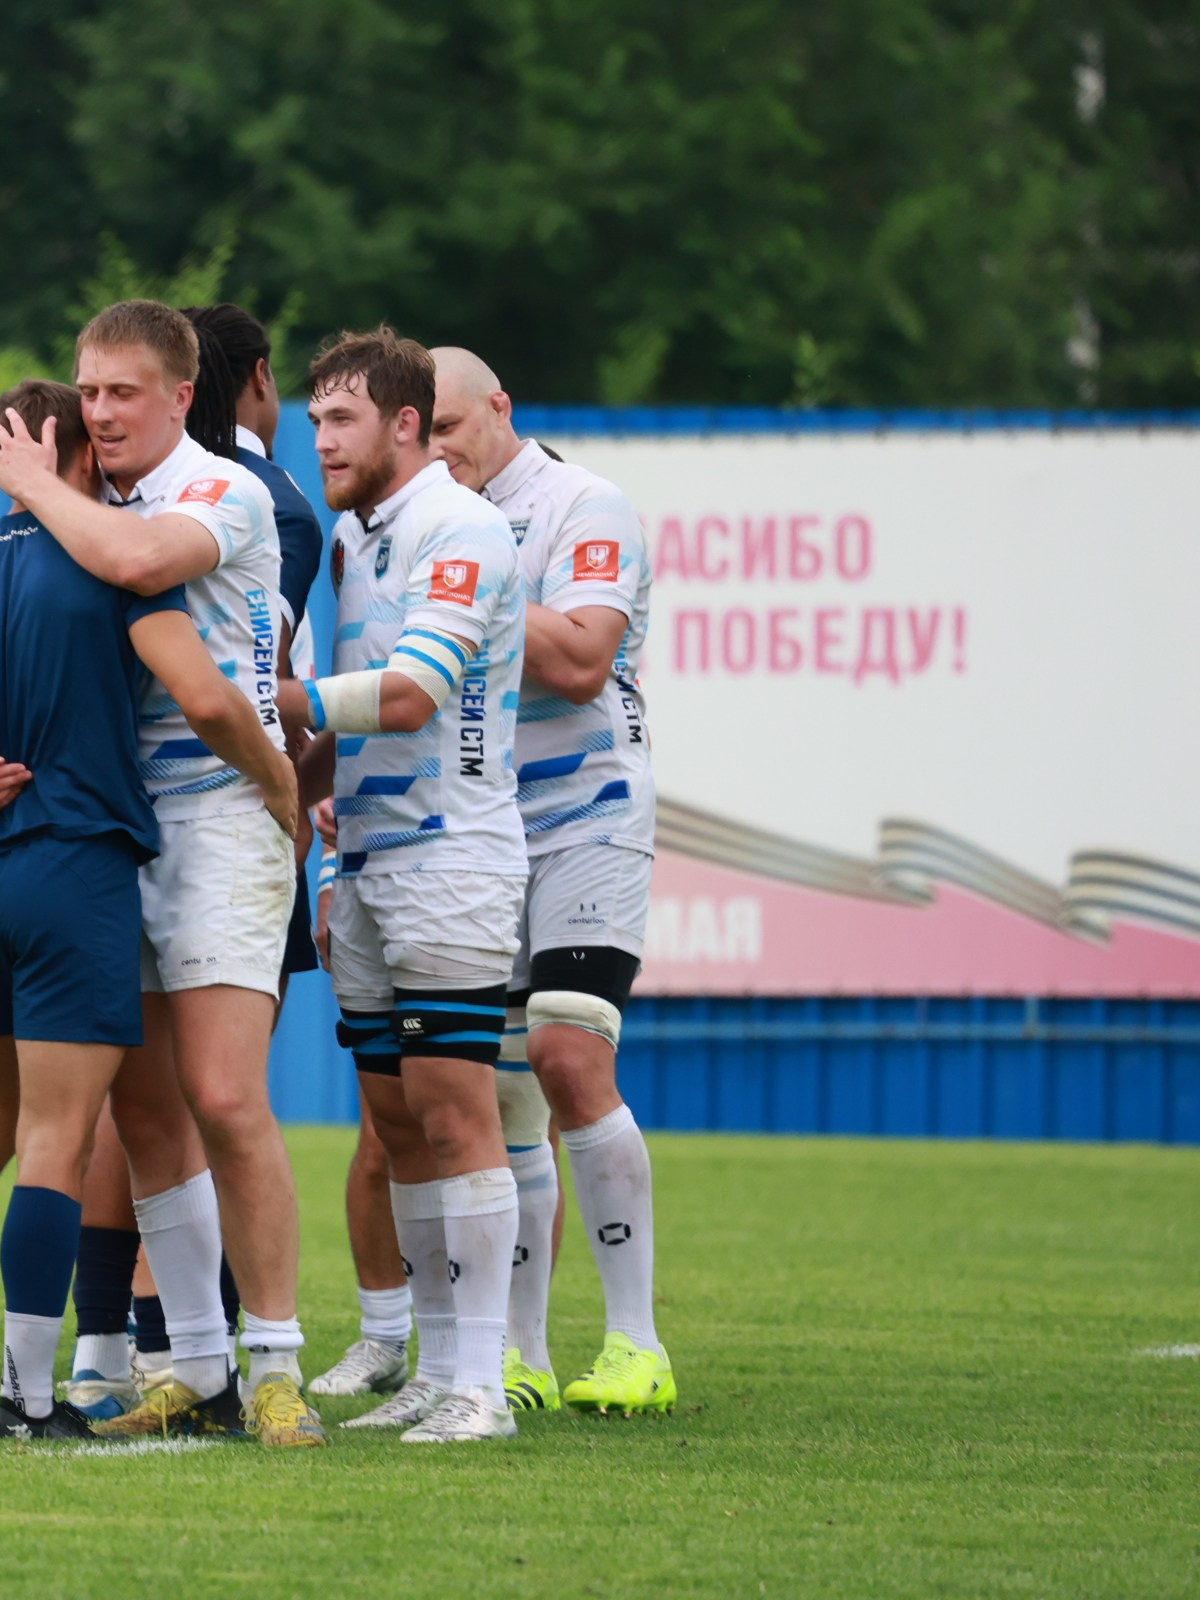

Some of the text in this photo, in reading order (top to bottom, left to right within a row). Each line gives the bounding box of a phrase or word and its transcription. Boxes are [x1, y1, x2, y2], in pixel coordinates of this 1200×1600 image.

[648, 513, 874, 582] АСИБО
[673, 605, 967, 686] ПОБЕДУ!
[460, 727, 485, 777] СТМ
